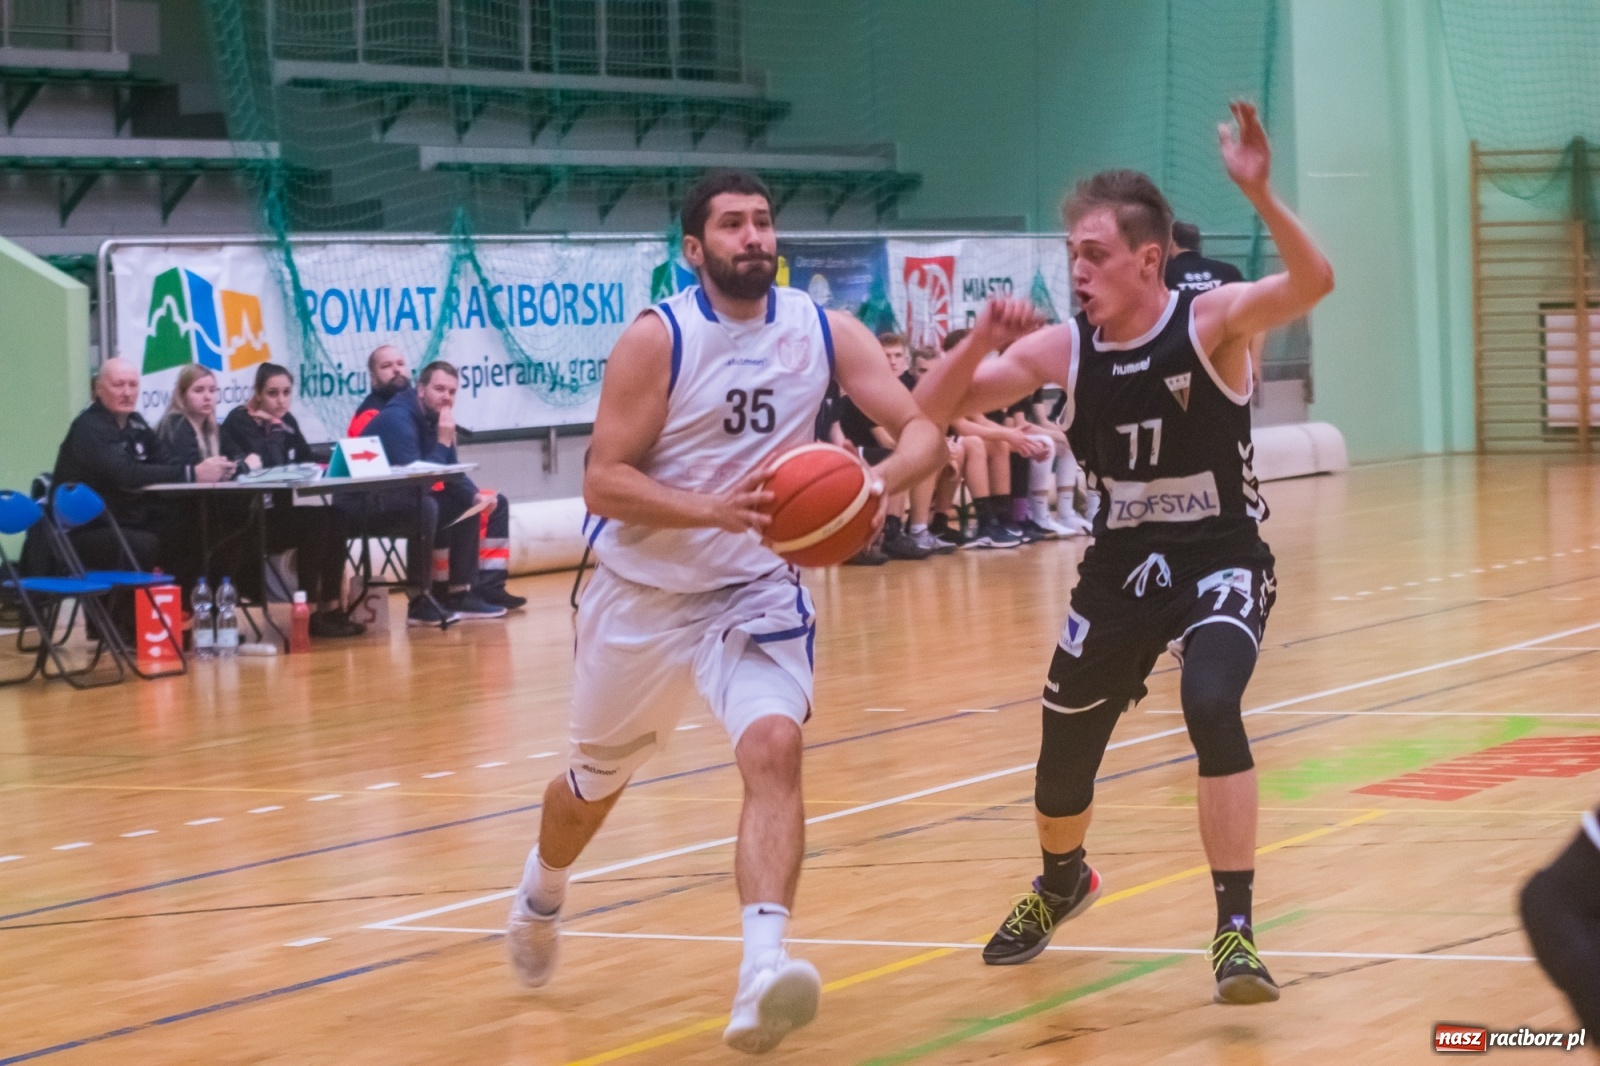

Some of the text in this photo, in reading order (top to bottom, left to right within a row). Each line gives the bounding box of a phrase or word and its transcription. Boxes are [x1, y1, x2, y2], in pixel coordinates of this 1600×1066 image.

[301, 282, 624, 336] POWIAT RACIBORSKI
[299, 362, 367, 398] kibicu
[458, 355, 565, 399] spieramy,
[723, 388, 776, 435] 35
[1115, 418, 1163, 470] 77
[1114, 491, 1217, 522] ZOFSTAL
